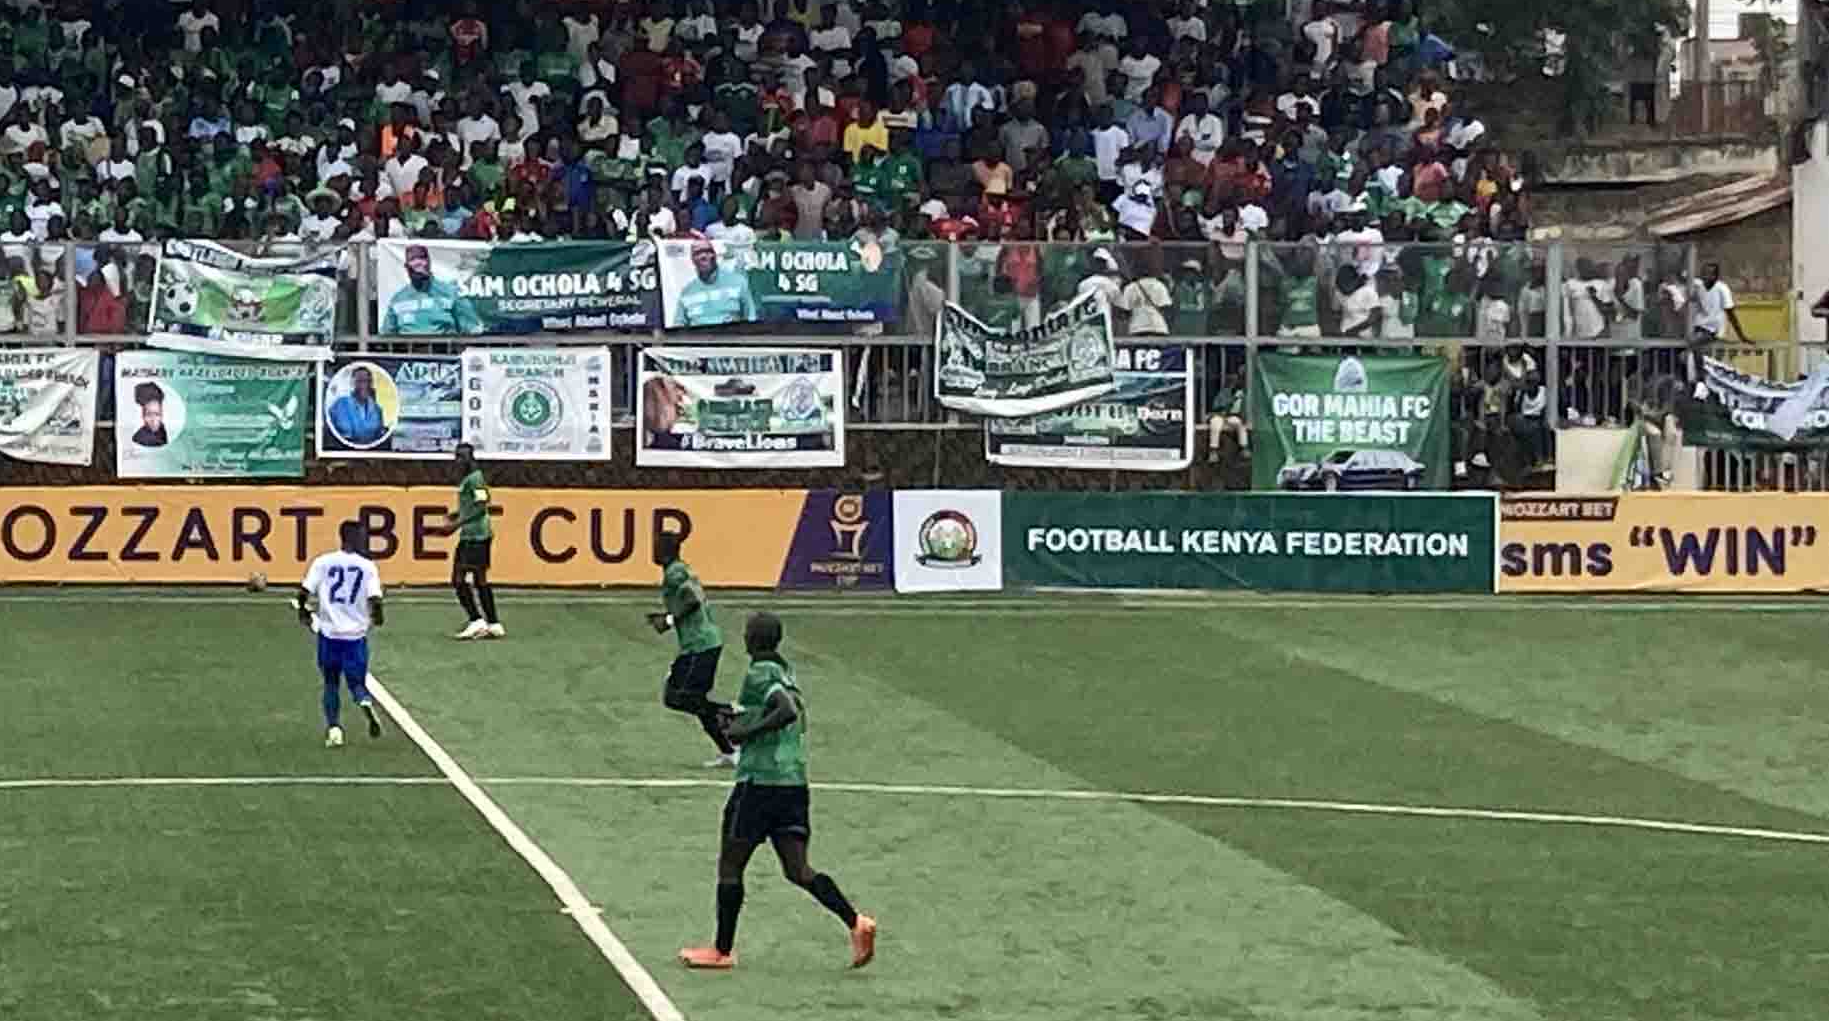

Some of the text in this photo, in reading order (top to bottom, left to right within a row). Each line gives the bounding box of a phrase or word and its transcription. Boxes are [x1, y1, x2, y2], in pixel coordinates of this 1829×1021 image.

[780, 251, 849, 271] OCHOLA
[458, 275, 504, 297] SAM
[512, 272, 600, 296] OCHOLA
[629, 267, 657, 291] SG
[795, 274, 819, 292] SG
[498, 298, 576, 311] SECRETARY
[1135, 349, 1161, 370] FC
[1273, 393, 1431, 419] GOR MAHIA FC
[1292, 419, 1412, 444] THE BEAST
[1581, 501, 1614, 517] BET
[529, 506, 693, 565] CUP
[1027, 528, 1469, 557] FOOTBALL KENYA FEDERATION
[1500, 525, 1817, 577] sms “WIN”
[328, 565, 364, 605] 27
